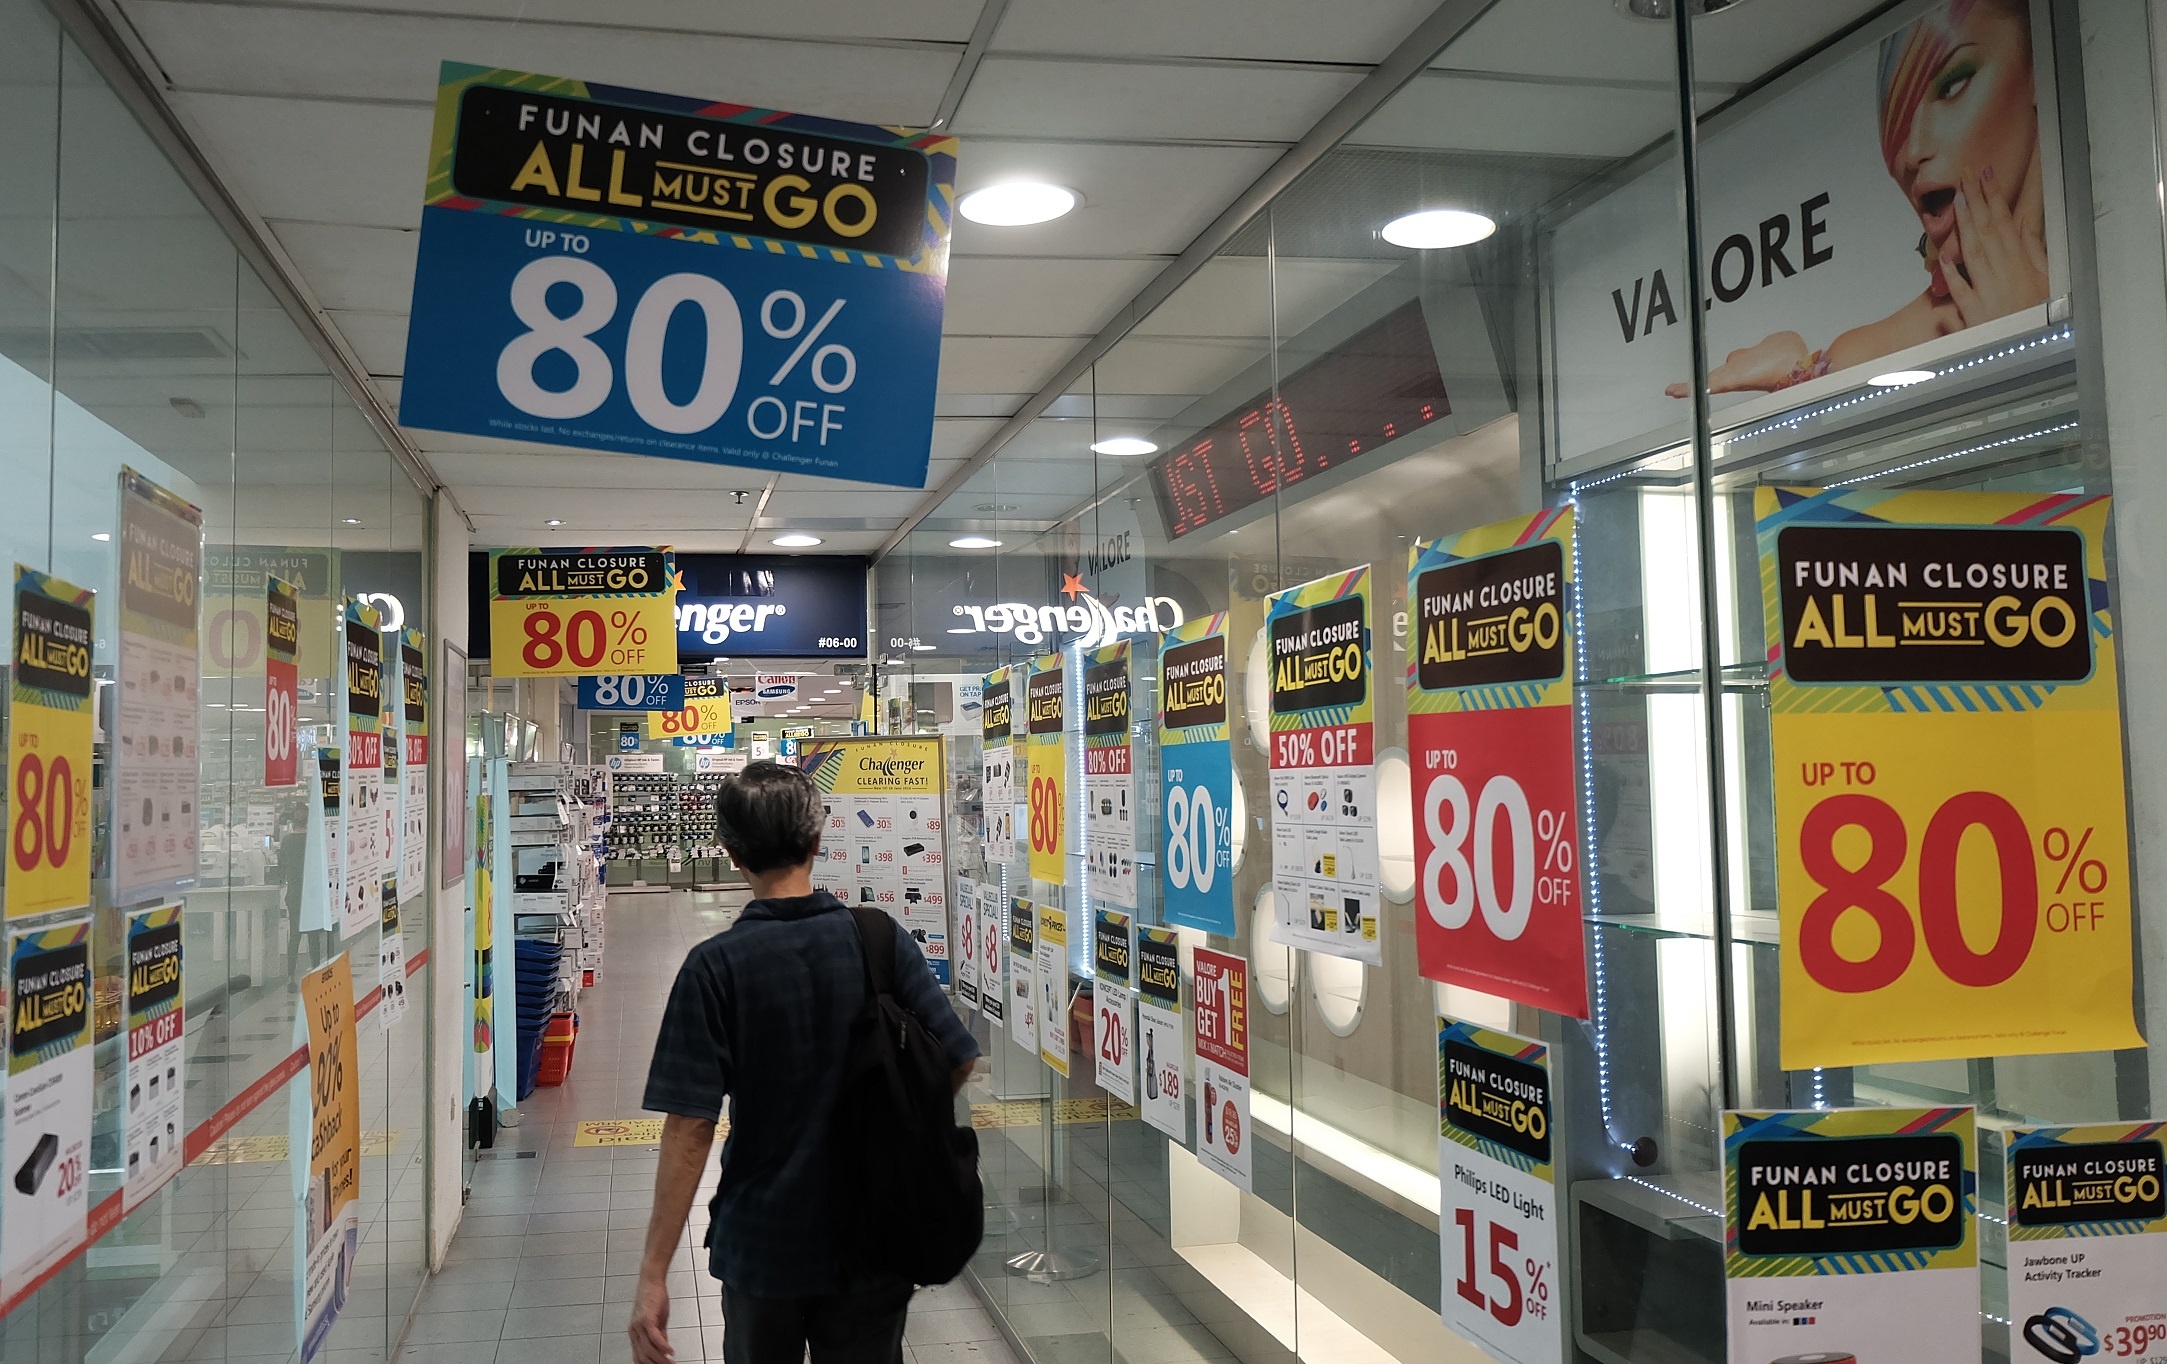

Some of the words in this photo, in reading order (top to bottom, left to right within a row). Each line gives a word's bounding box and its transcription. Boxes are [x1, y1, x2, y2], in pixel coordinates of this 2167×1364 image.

[518, 104, 665, 151] FUNAN
[687, 130, 877, 182] CLOSURE
[510, 138, 643, 207] ALL
[762, 174, 878, 238] GO
[524, 228, 557, 250] UP
[561, 231, 590, 254] TO
[1612, 191, 1833, 343] VAORE
[496, 256, 857, 434] 80%
[747, 396, 846, 447] OFF
[518, 559, 569, 569] FUNAN
[577, 557, 646, 568] CLOSURE
[1794, 560, 1907, 591] FUNAN
[1922, 562, 2069, 591] CLOSURE
[519, 570, 565, 591] ALL
[607, 568, 648, 589] GO
[1423, 589, 1474, 618] FUNAN
[1480, 572, 1556, 607] CLOSURE
[1423, 618, 1466, 665] ALL
[1508, 602, 1560, 652] GO
[1792, 593, 1896, 649] ALL
[1984, 593, 2077, 649] GO
[523, 610, 647, 668] 80%
[611, 649, 645, 664] OFF
[818, 637, 857, 648] #06-00
[1276, 633, 1307, 655] FUNAN
[1310, 620, 1360, 647] CLOSURE
[20, 632, 47, 669] ALL
[67, 643, 89, 678] GO
[1167, 663, 1189, 680] FUNAN
[1191, 655, 1223, 675] CLOSURE
[1275, 655, 1304, 693] ALL
[1329, 643, 1362, 683] GO
[698, 685, 717, 696] GO
[1103, 676, 1126, 691] CLOSURE
[1166, 681, 1186, 712] ALL
[1203, 674, 1224, 705] GO
[646, 696, 667, 705] OFF
[1031, 700, 1042, 721] ALL
[1051, 696, 1062, 719] GO
[1087, 696, 1101, 721] ALL
[1112, 691, 1127, 717] GO
[701, 722, 717, 730] OFF
[365, 736, 378, 766] OFF
[414, 736, 422, 762] OFF
[1278, 732, 1314, 767] 50%
[1320, 728, 1357, 765] OFF
[1425, 750, 1440, 769] UP
[1441, 750, 1457, 769] TO
[609, 757, 622, 769] hp
[699, 757, 710, 769] hp
[860, 756, 924, 776] Challenger
[1089, 750, 1106, 773] 80%
[1109, 749, 1126, 773] OFF
[1801, 762, 1834, 786] UP
[1840, 761, 1876, 786] TO
[857, 777, 900, 785] CLEARING
[904, 777, 928, 785] FAST!
[1168, 769, 1175, 782] UP
[1175, 770, 1182, 782] TO
[14, 753, 89, 872] 80%
[927, 821, 940, 830] $89
[1167, 785, 1230, 893] 80%
[1216, 849, 1230, 868] OFF
[830, 851, 847, 860] $299
[875, 853, 892, 861] $398
[923, 854, 941, 863] $399
[1423, 774, 1572, 941] 80%
[1538, 876, 1571, 906] OFF
[877, 893, 894, 902] $556
[924, 895, 942, 904] $499
[1798, 790, 2108, 994] 80%
[2046, 902, 2105, 933] OFF
[926, 944, 945, 954] $899
[1117, 948, 1128, 968] GO
[163, 955, 179, 984] GO
[1141, 963, 1153, 983] ALL
[1163, 968, 1176, 989] GO
[1196, 960, 1217, 977] VALORE
[15, 994, 41, 1034] ALL
[64, 981, 85, 1016] GO
[1196, 975, 1217, 1007] BUY
[1218, 968, 1231, 1046] 1
[1230, 969, 1244, 1051] FREE
[320, 1004, 331, 1038] Up
[332, 1003, 339, 1024] to
[1197, 1006, 1218, 1040] GET
[131, 1024, 154, 1059] 10%
[157, 1012, 177, 1044] OFF
[1102, 1008, 1128, 1066] 20%
[1158, 1069, 1179, 1100] $189
[1449, 1058, 1486, 1084] FUNAN
[1489, 1072, 1543, 1106] CLOSURE
[1449, 1078, 1482, 1116] ALL
[1511, 1101, 1546, 1140] GO
[1751, 1165, 1836, 1186] FUNAN
[1846, 1160, 1950, 1183] CLOSURE
[2023, 1163, 2077, 1179] FUNAN
[2084, 1158, 2156, 1175] CLOSURE
[1454, 1164, 1487, 1195] Philips
[1489, 1181, 1510, 1204] LED
[1513, 1195, 1545, 1221] Light
[2022, 1179, 2071, 1209] ALL
[2114, 1174, 2160, 1203] GO
[1747, 1189, 1825, 1231] ALL
[1888, 1184, 1954, 1224] GO
[2024, 1255, 2067, 1267] Jawbone
[2070, 1253, 2085, 1264] UP
[2025, 1270, 2063, 1282] Activity
[2067, 1268, 2102, 1279] Tracker
[1526, 1297, 1547, 1320] OFF
[1747, 1301, 1774, 1311] Mini
[1777, 1299, 1824, 1314] Speaker
[2126, 1313, 2166, 1323] PROMOTION
